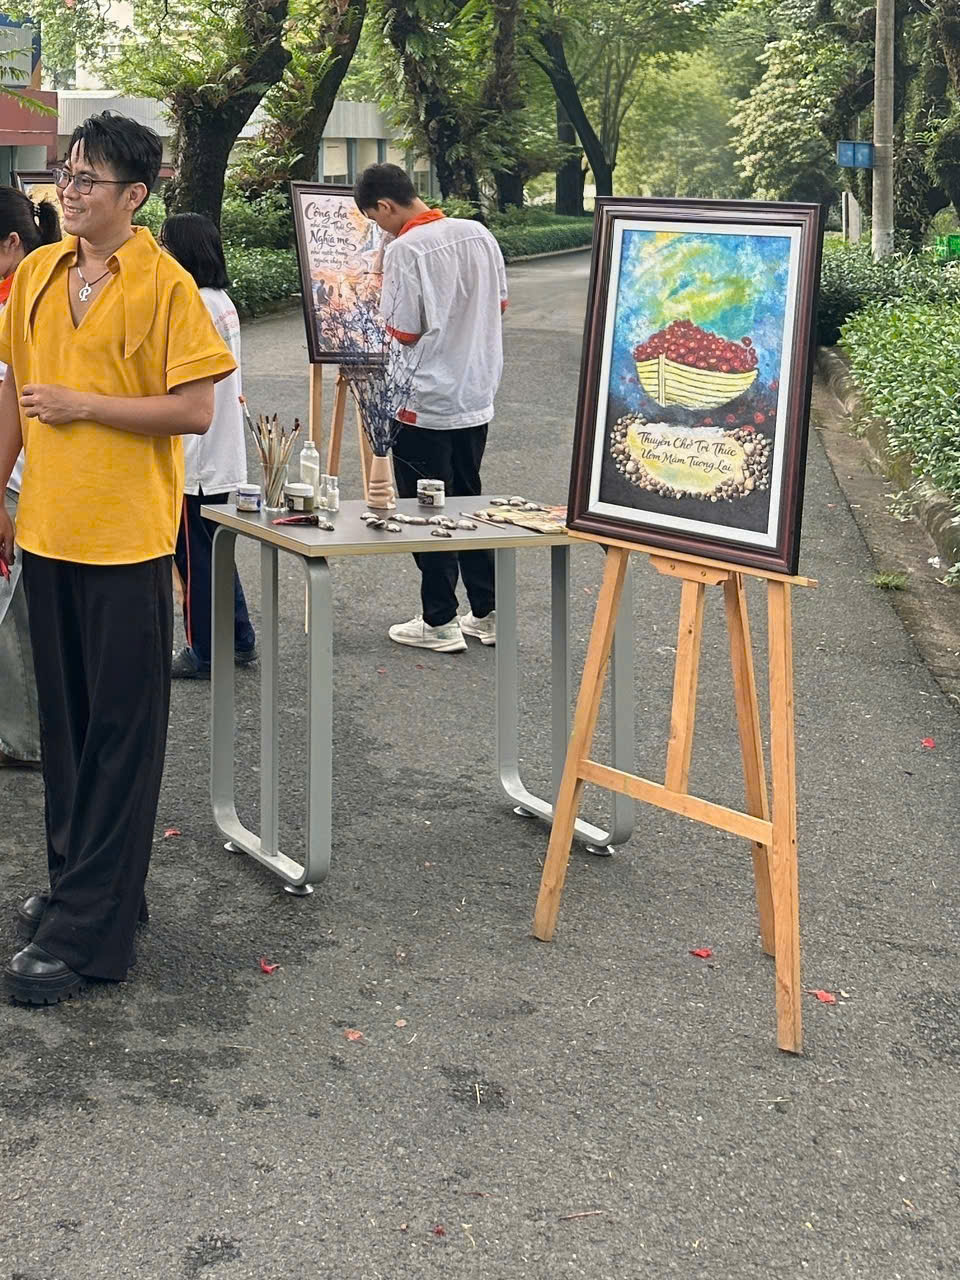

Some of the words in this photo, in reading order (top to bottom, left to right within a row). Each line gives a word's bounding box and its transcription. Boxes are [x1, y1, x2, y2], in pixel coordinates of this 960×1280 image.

[304, 201, 331, 225] Công
[333, 205, 350, 220] cha
[308, 229, 337, 250] Nghĩa
[337, 236, 357, 251] mẹ
[637, 431, 672, 450] Thuyền
[672, 437, 693, 450] Chở
[711, 442, 738, 458] Thức
[640, 448, 661, 461] Ươm
[686, 455, 715, 474] Tương
[715, 459, 732, 474] Lai
